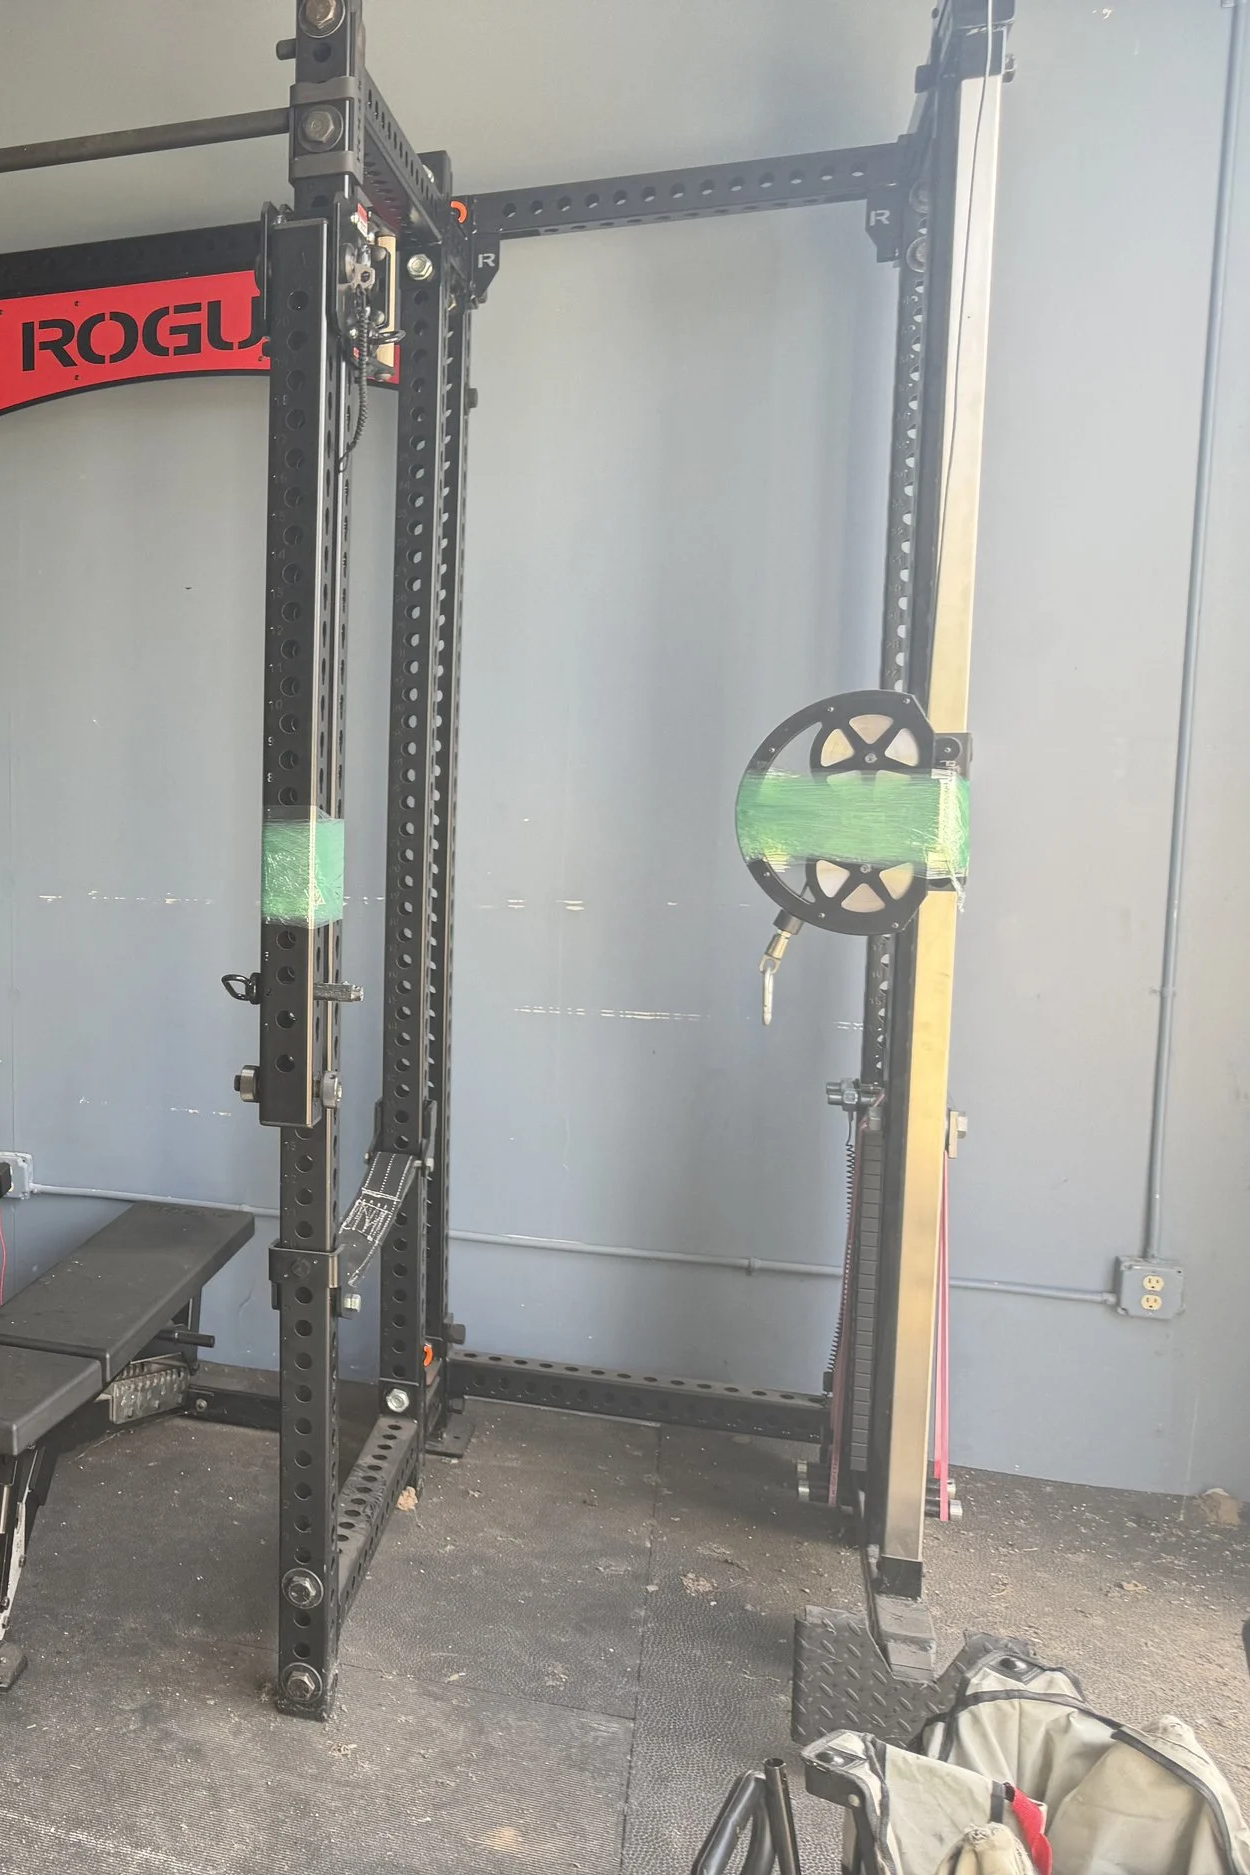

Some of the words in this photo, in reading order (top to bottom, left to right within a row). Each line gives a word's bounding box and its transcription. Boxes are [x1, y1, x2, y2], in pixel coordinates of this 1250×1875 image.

[869, 210, 890, 225] R
[478, 253, 495, 268] R
[22, 300, 264, 371] ROGU
